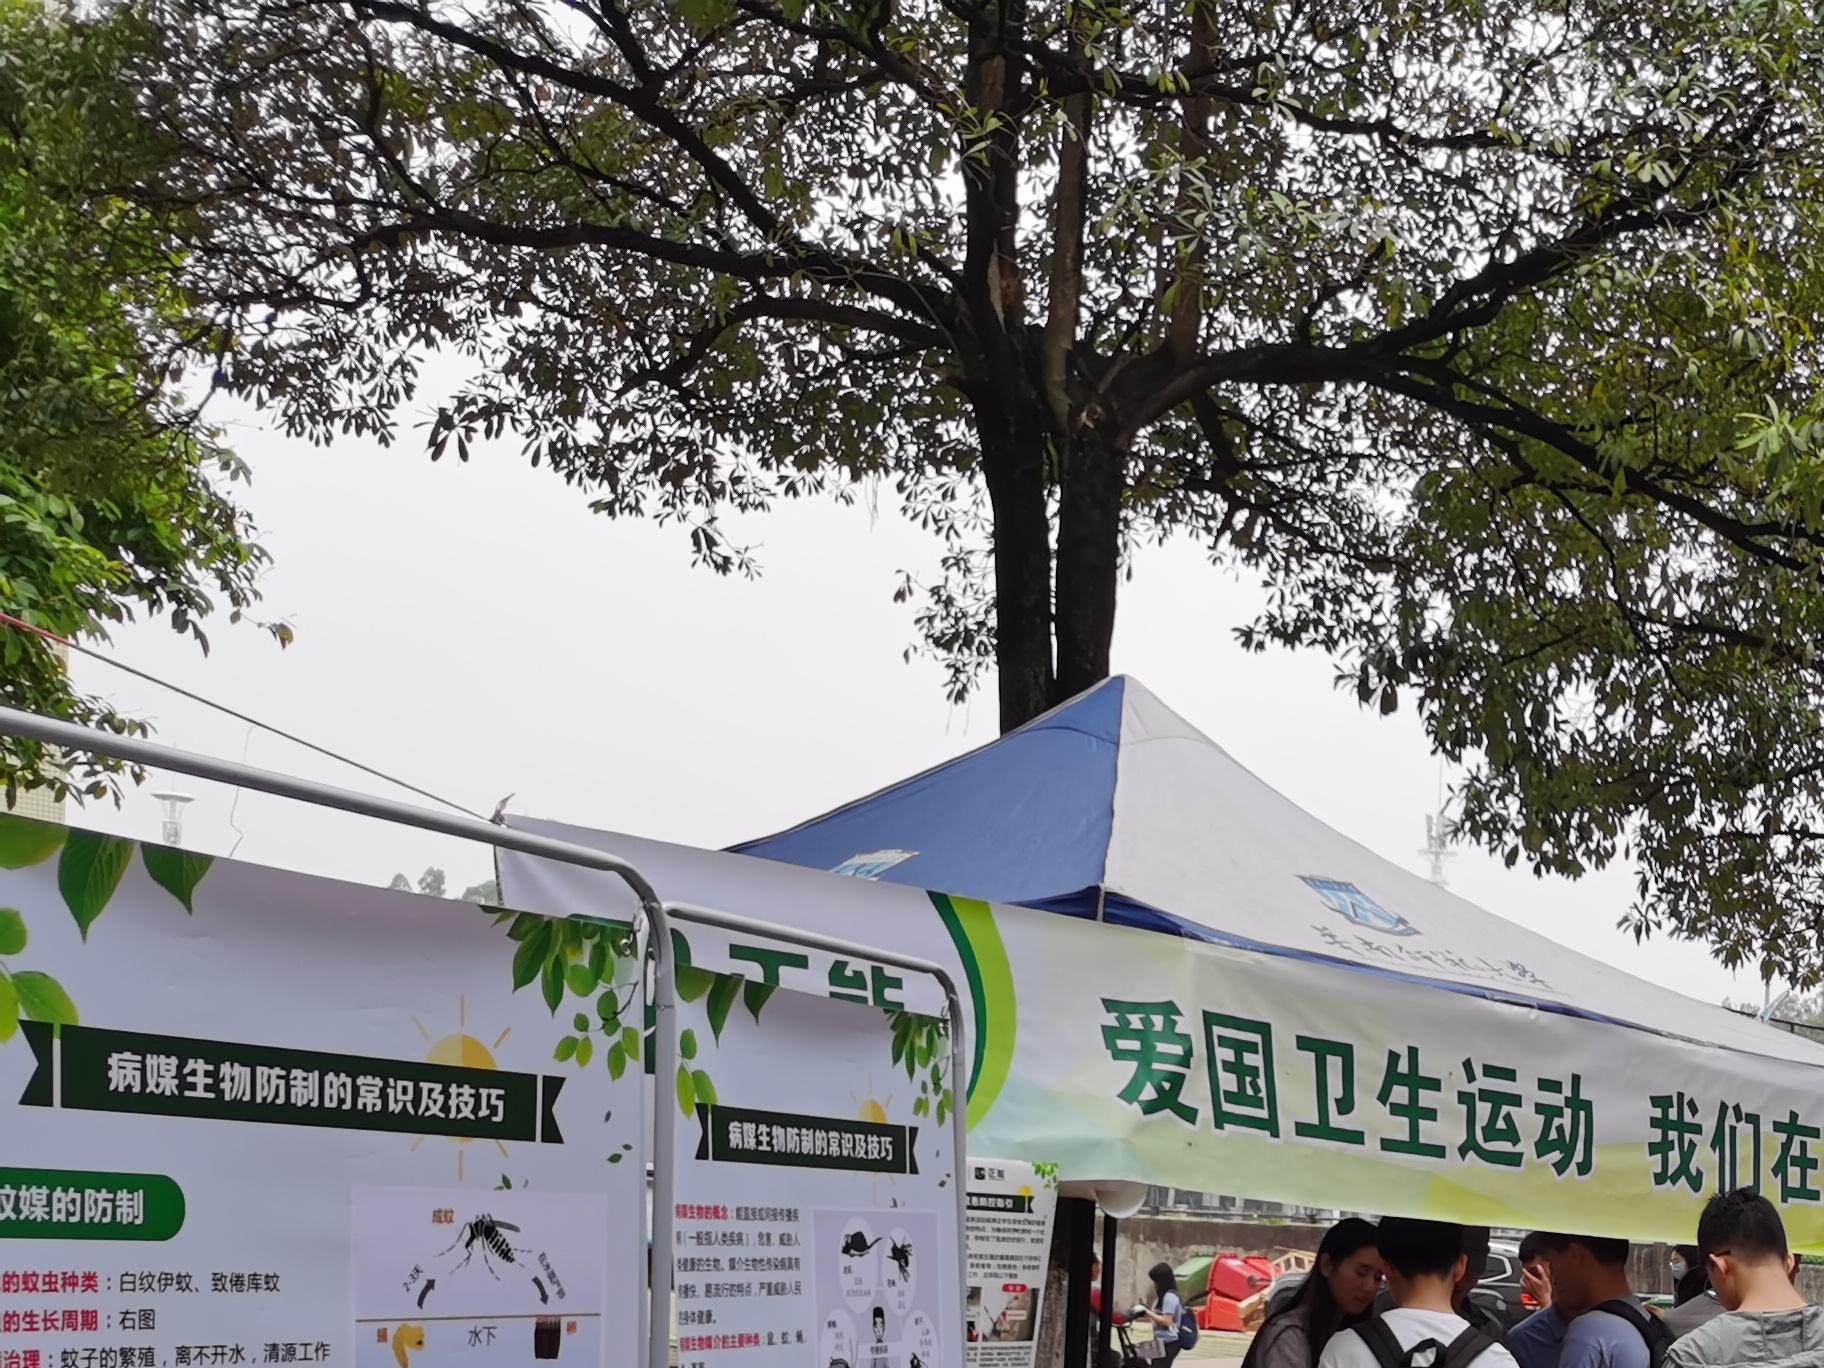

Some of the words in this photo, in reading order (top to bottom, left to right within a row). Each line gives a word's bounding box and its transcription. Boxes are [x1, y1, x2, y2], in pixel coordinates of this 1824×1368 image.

[106, 1050, 506, 1122] 病媒生物防制的常识及技巧
[1100, 998, 1594, 1177] 爱国卫生运动
[728, 1120, 894, 1162] 病媒生物防制的常识及技巧
[0, 1270, 281, 1294] 的蚊虫种类：白纹伊蚊、致倦库蚊
[0, 1309, 156, 1333] 的生长周期：右图
[467, 1326, 498, 1347] 水下
